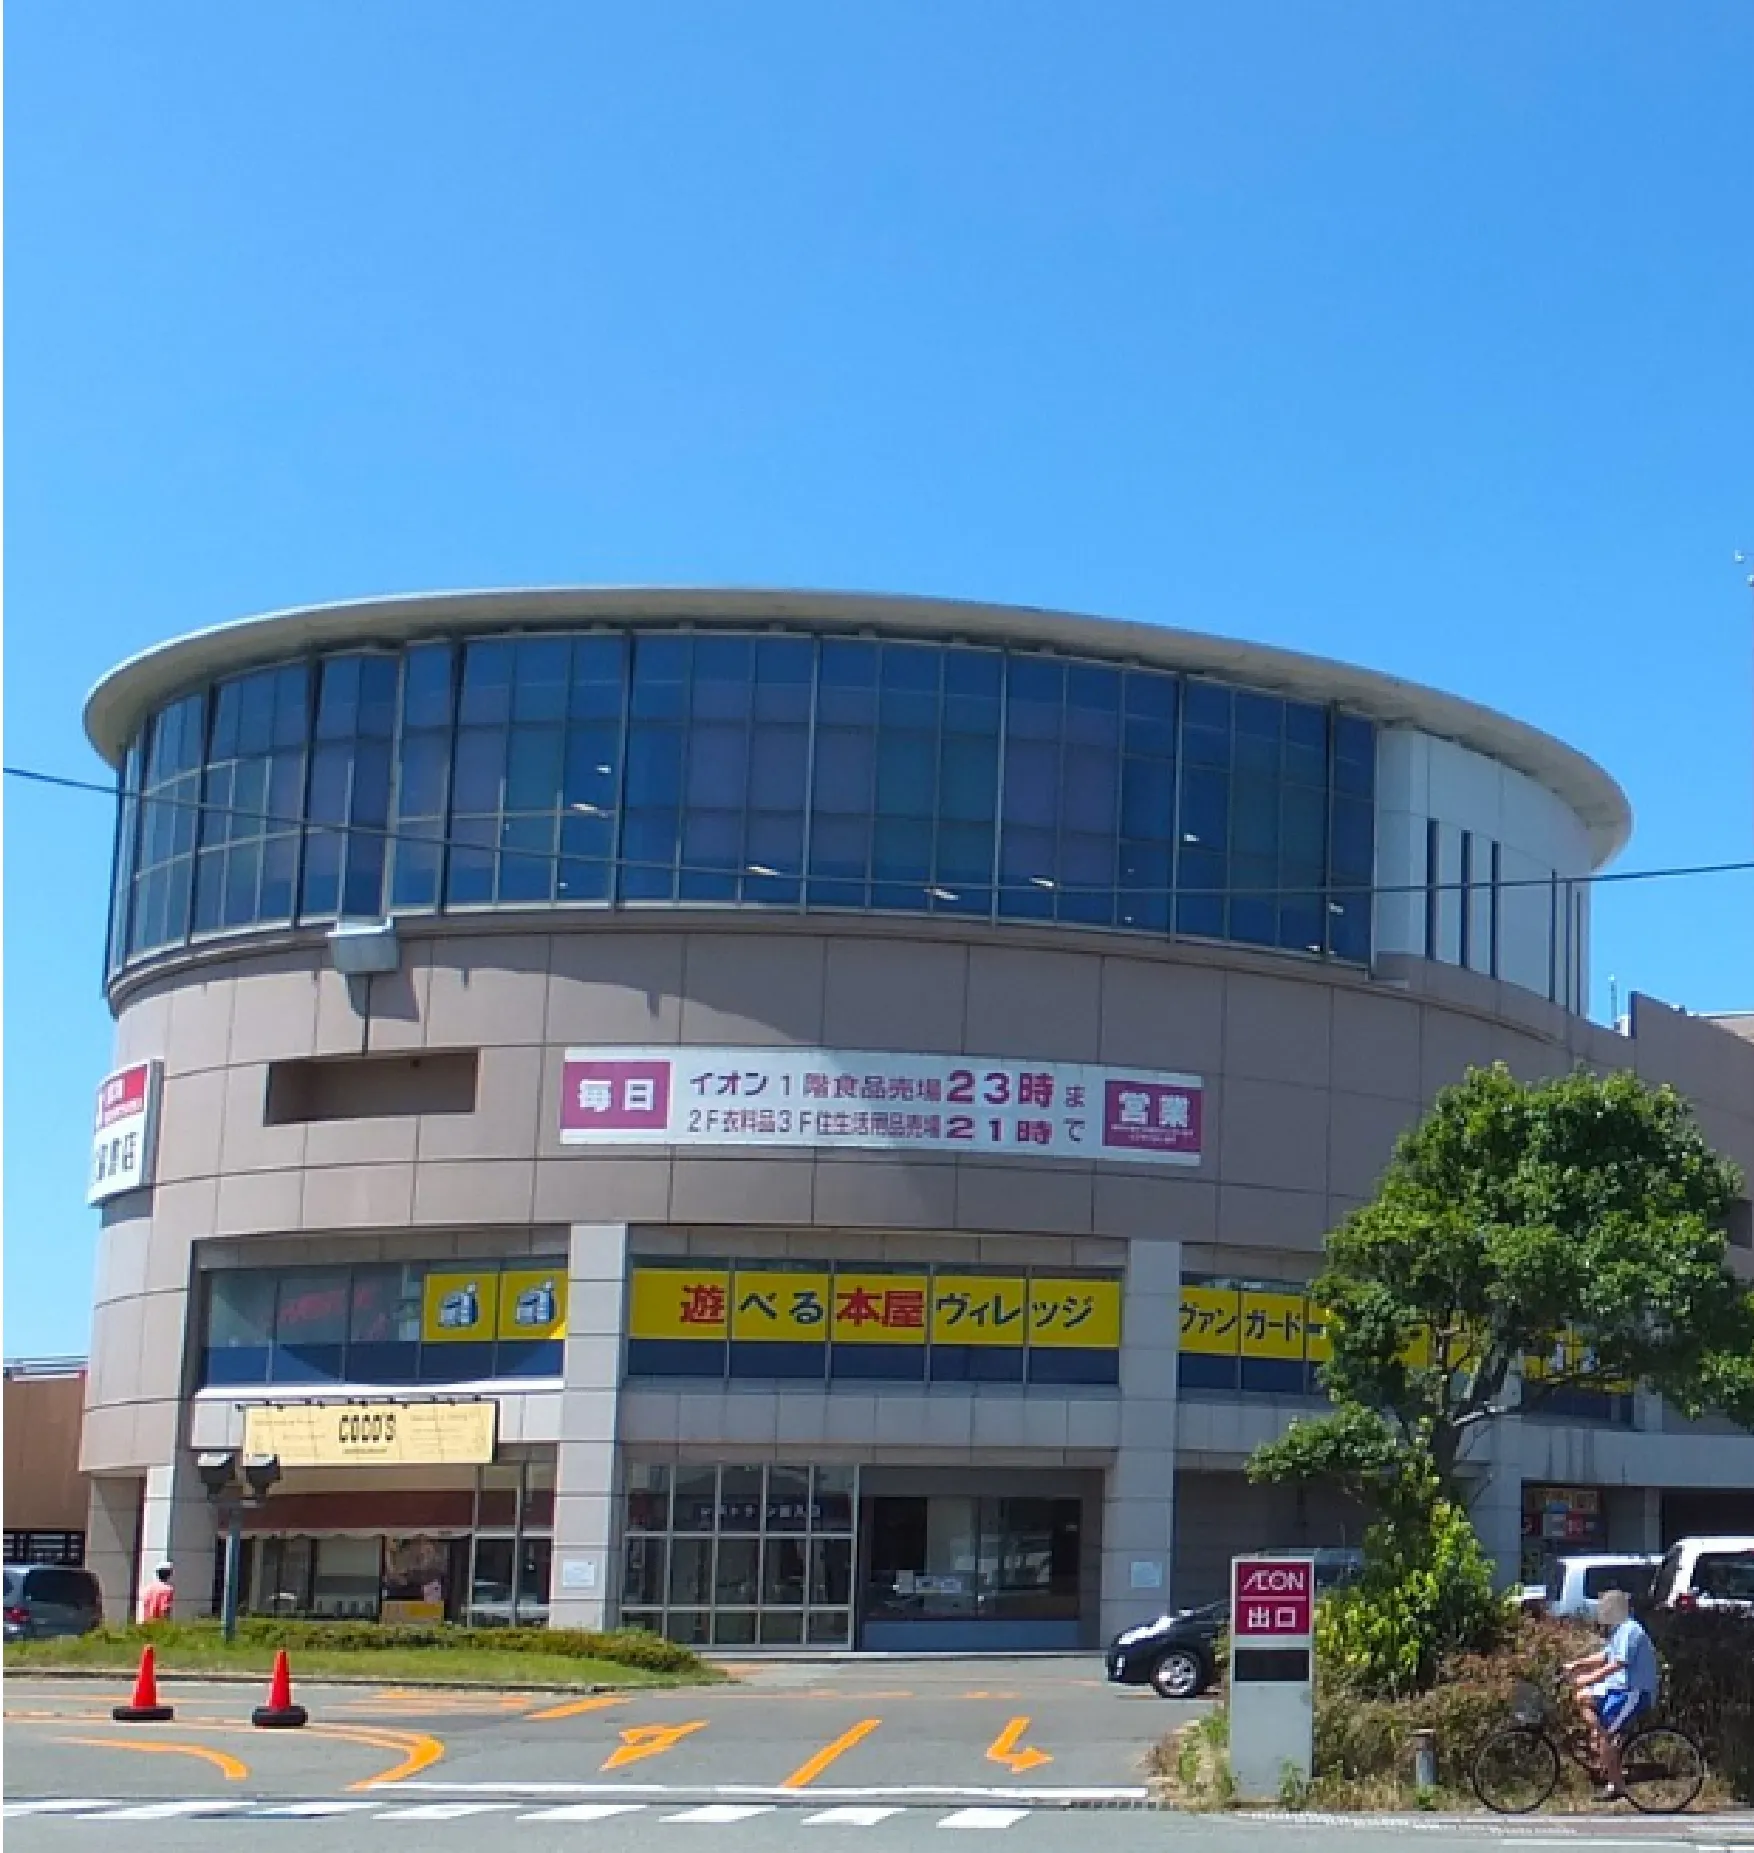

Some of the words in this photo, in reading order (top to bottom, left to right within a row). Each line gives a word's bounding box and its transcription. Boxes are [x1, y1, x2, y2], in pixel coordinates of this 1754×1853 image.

[578, 1078, 655, 1112] 毎日
[1118, 1090, 1191, 1128] 営業
[339, 1414, 397, 1444] COCO'S
[1247, 1604, 1297, 1628] 出口
